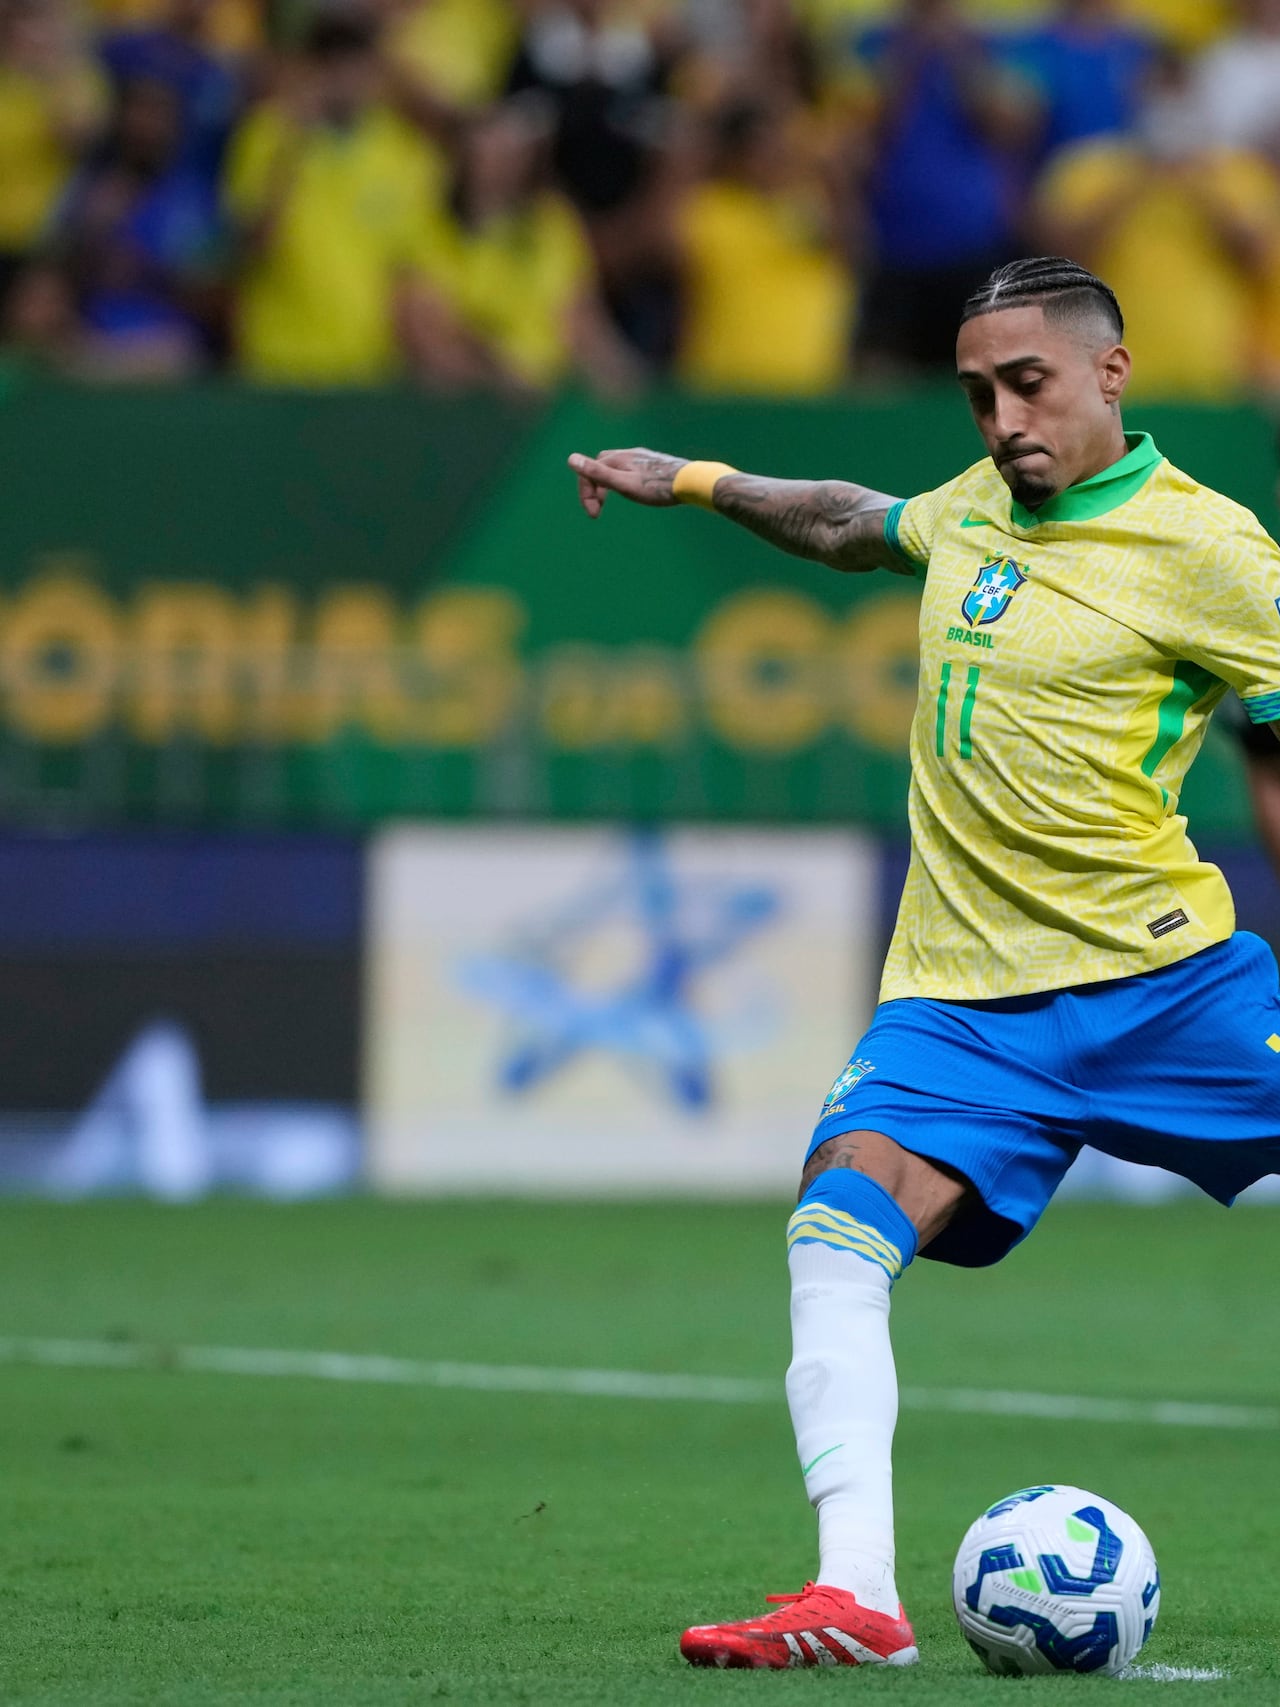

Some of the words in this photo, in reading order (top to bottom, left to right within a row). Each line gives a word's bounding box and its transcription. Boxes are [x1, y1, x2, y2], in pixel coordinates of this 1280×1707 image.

[982, 584, 1002, 597] CBF
[946, 627, 995, 649] BRASIL
[936, 661, 981, 760] 11
